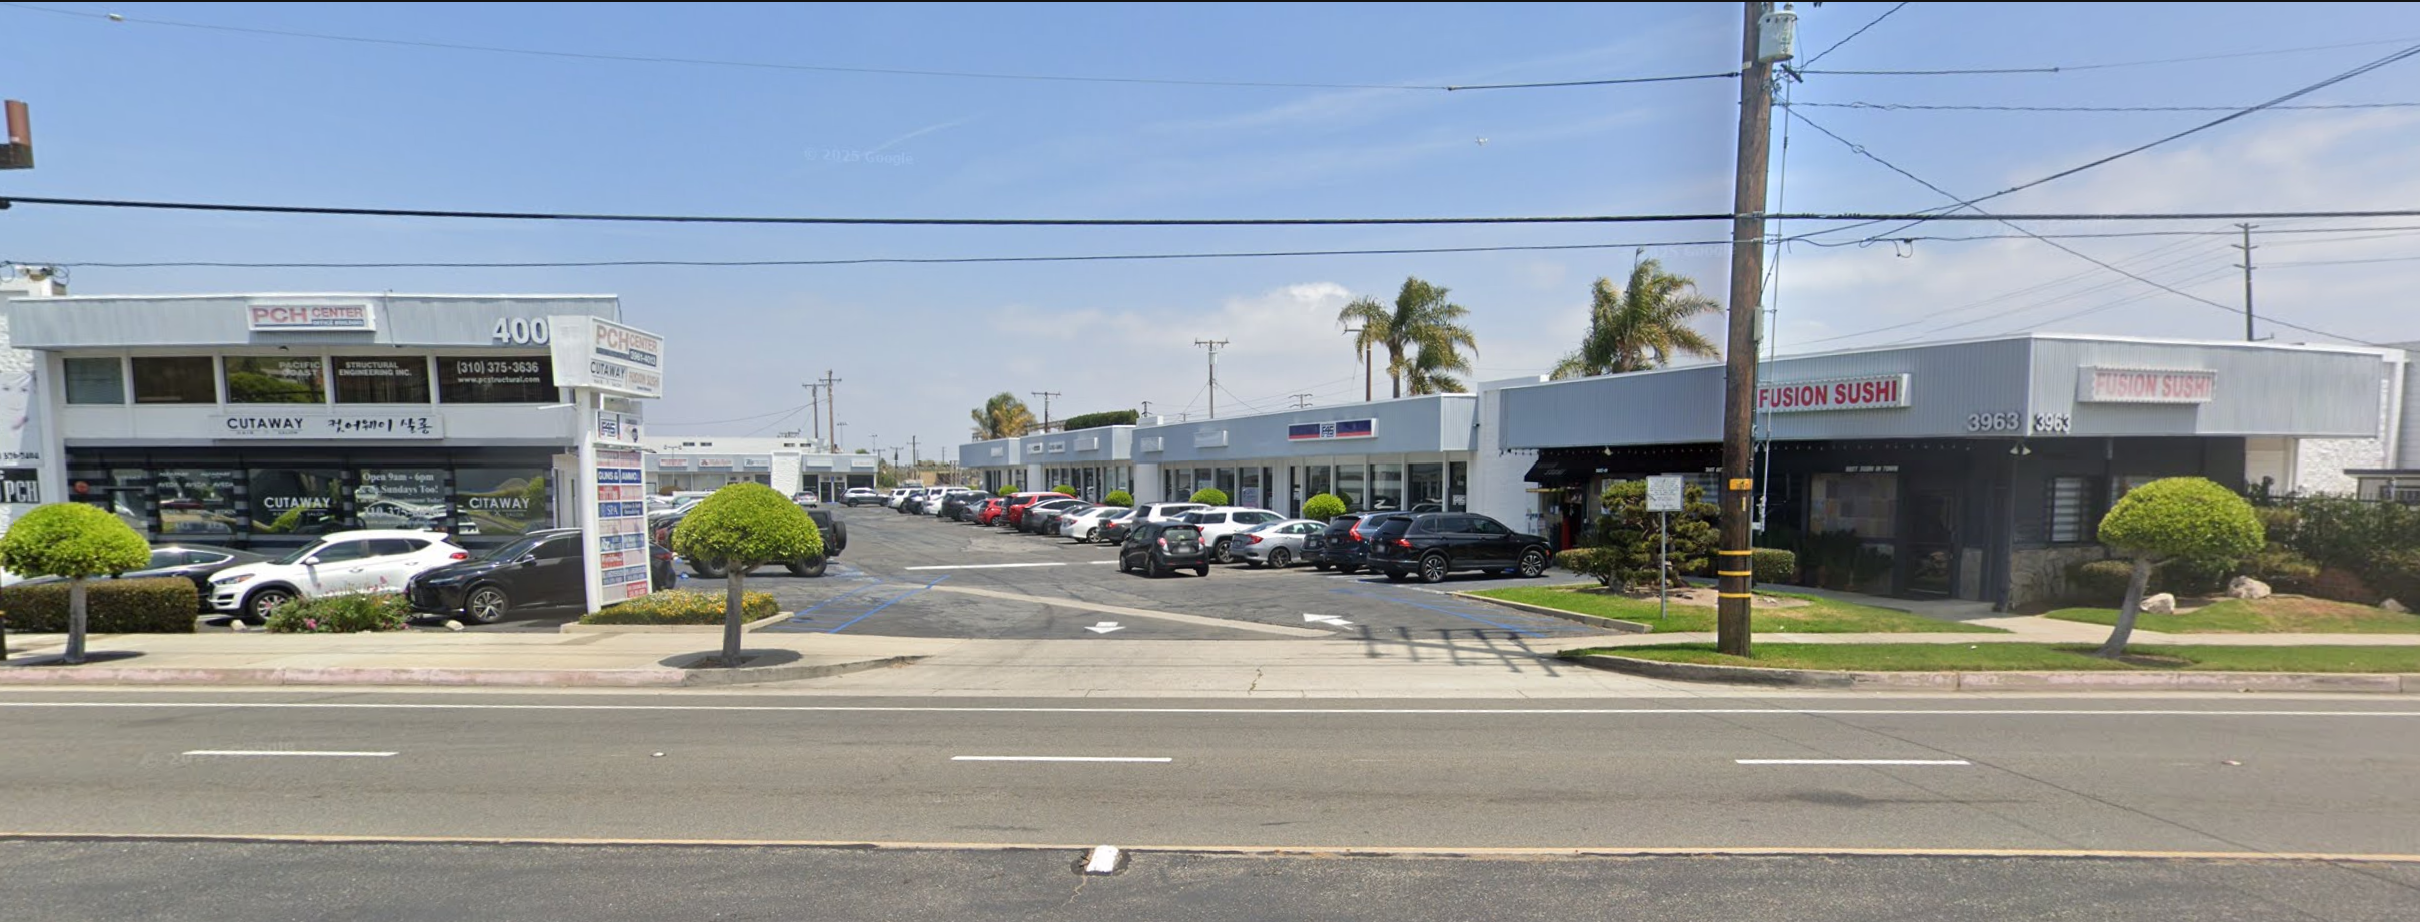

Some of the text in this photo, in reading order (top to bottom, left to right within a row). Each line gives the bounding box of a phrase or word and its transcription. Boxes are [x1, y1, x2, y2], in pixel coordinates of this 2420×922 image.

[252, 307, 364, 323] PCH CENTER
[596, 324, 658, 354] PCH CENTER
[279, 361, 321, 369] PACIFIC
[345, 361, 400, 369] STRUCTURAL
[456, 361, 485, 375] (310)
[590, 361, 626, 379] CUTAWAY
[338, 369, 394, 377] ENGINEERING
[2094, 372, 2213, 399] FUSION SUSHI
[1758, 380, 1898, 409] FUSION SUSHI
[226, 417, 304, 430] CUTAWAY
[1967, 411, 2020, 432] 3963
[2035, 412, 2072, 433] 3963
[362, 472, 387, 482] Open
[388, 472, 407, 481] 9am
[414, 472, 434, 483] 6pm
[4, 480, 40, 503] PCH
[381, 485, 418, 496] Sundays
[420, 485, 439, 494] Too!
[263, 497, 331, 509] CUTAWAY
